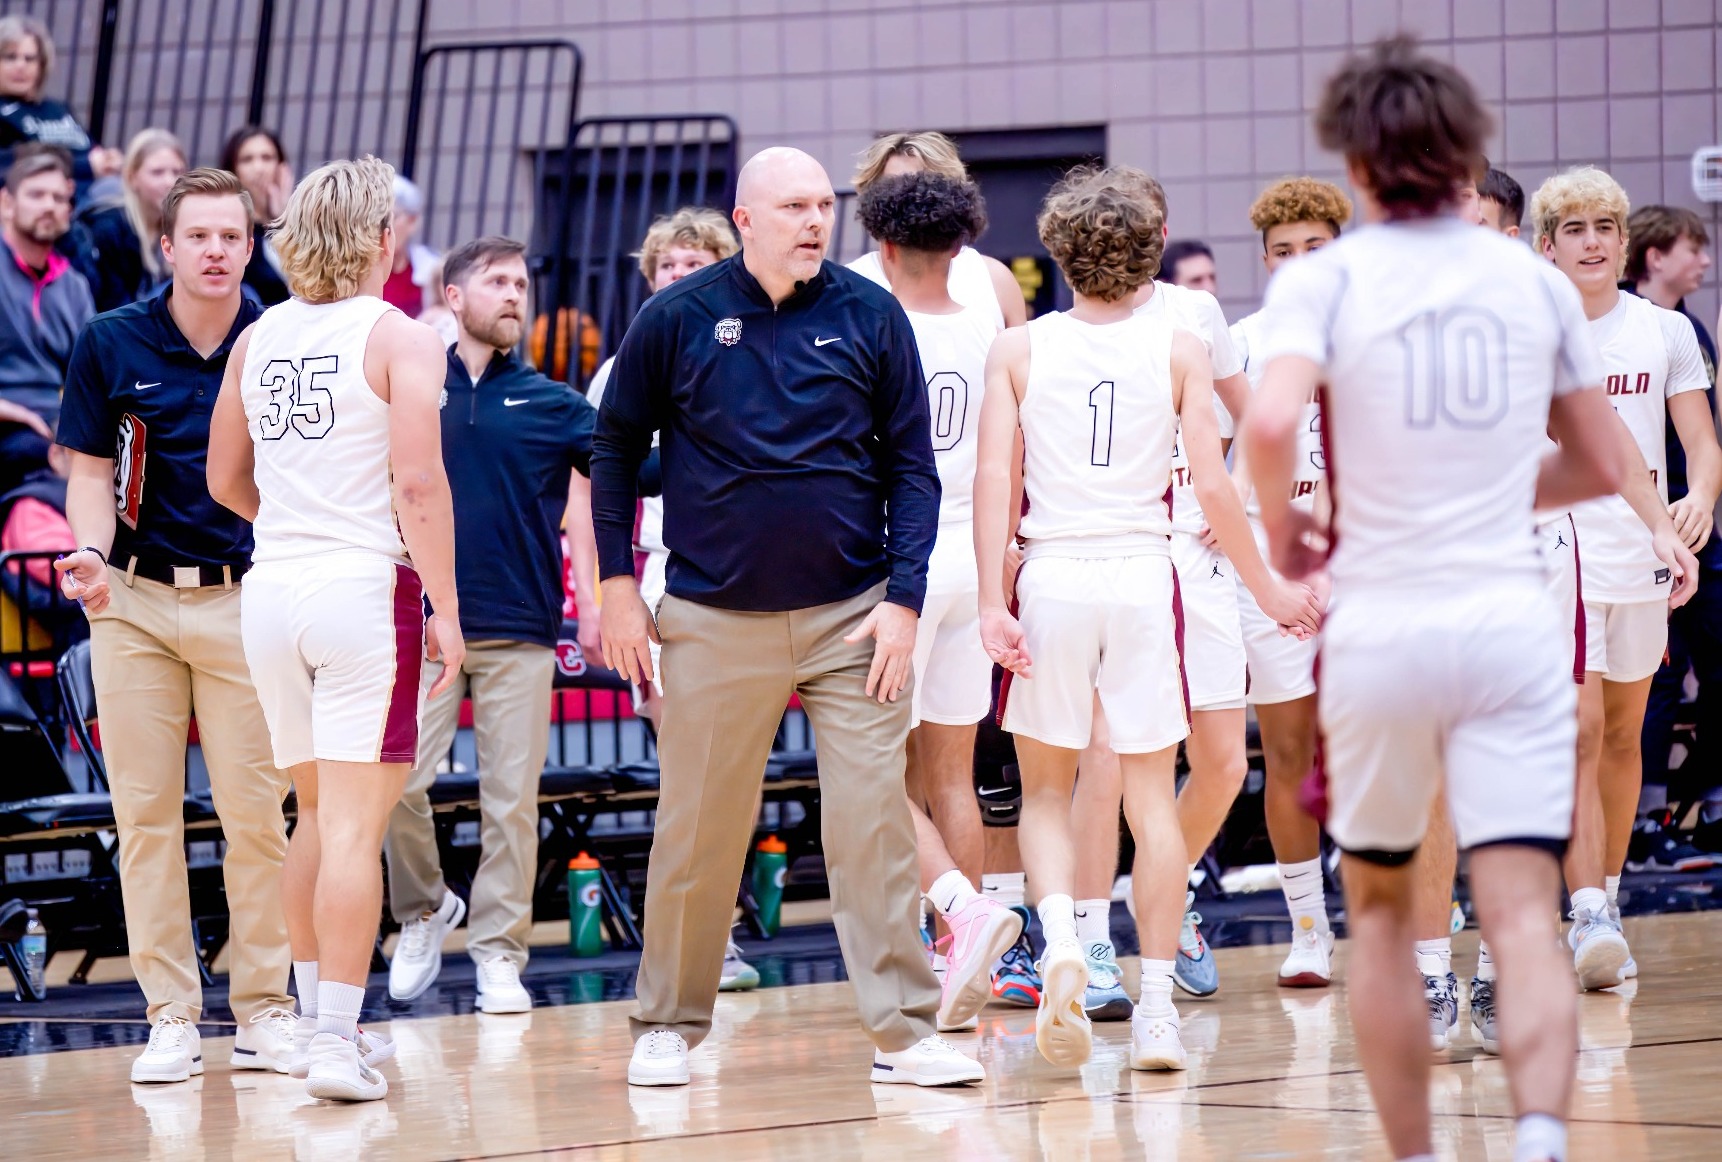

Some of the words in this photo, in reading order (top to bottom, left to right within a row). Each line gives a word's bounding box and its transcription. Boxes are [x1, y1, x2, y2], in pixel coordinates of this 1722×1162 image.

[260, 354, 339, 440] 35
[1396, 304, 1510, 429] 10
[1606, 372, 1650, 396] OLN
[926, 371, 968, 452] 0
[1088, 380, 1115, 467] 1
